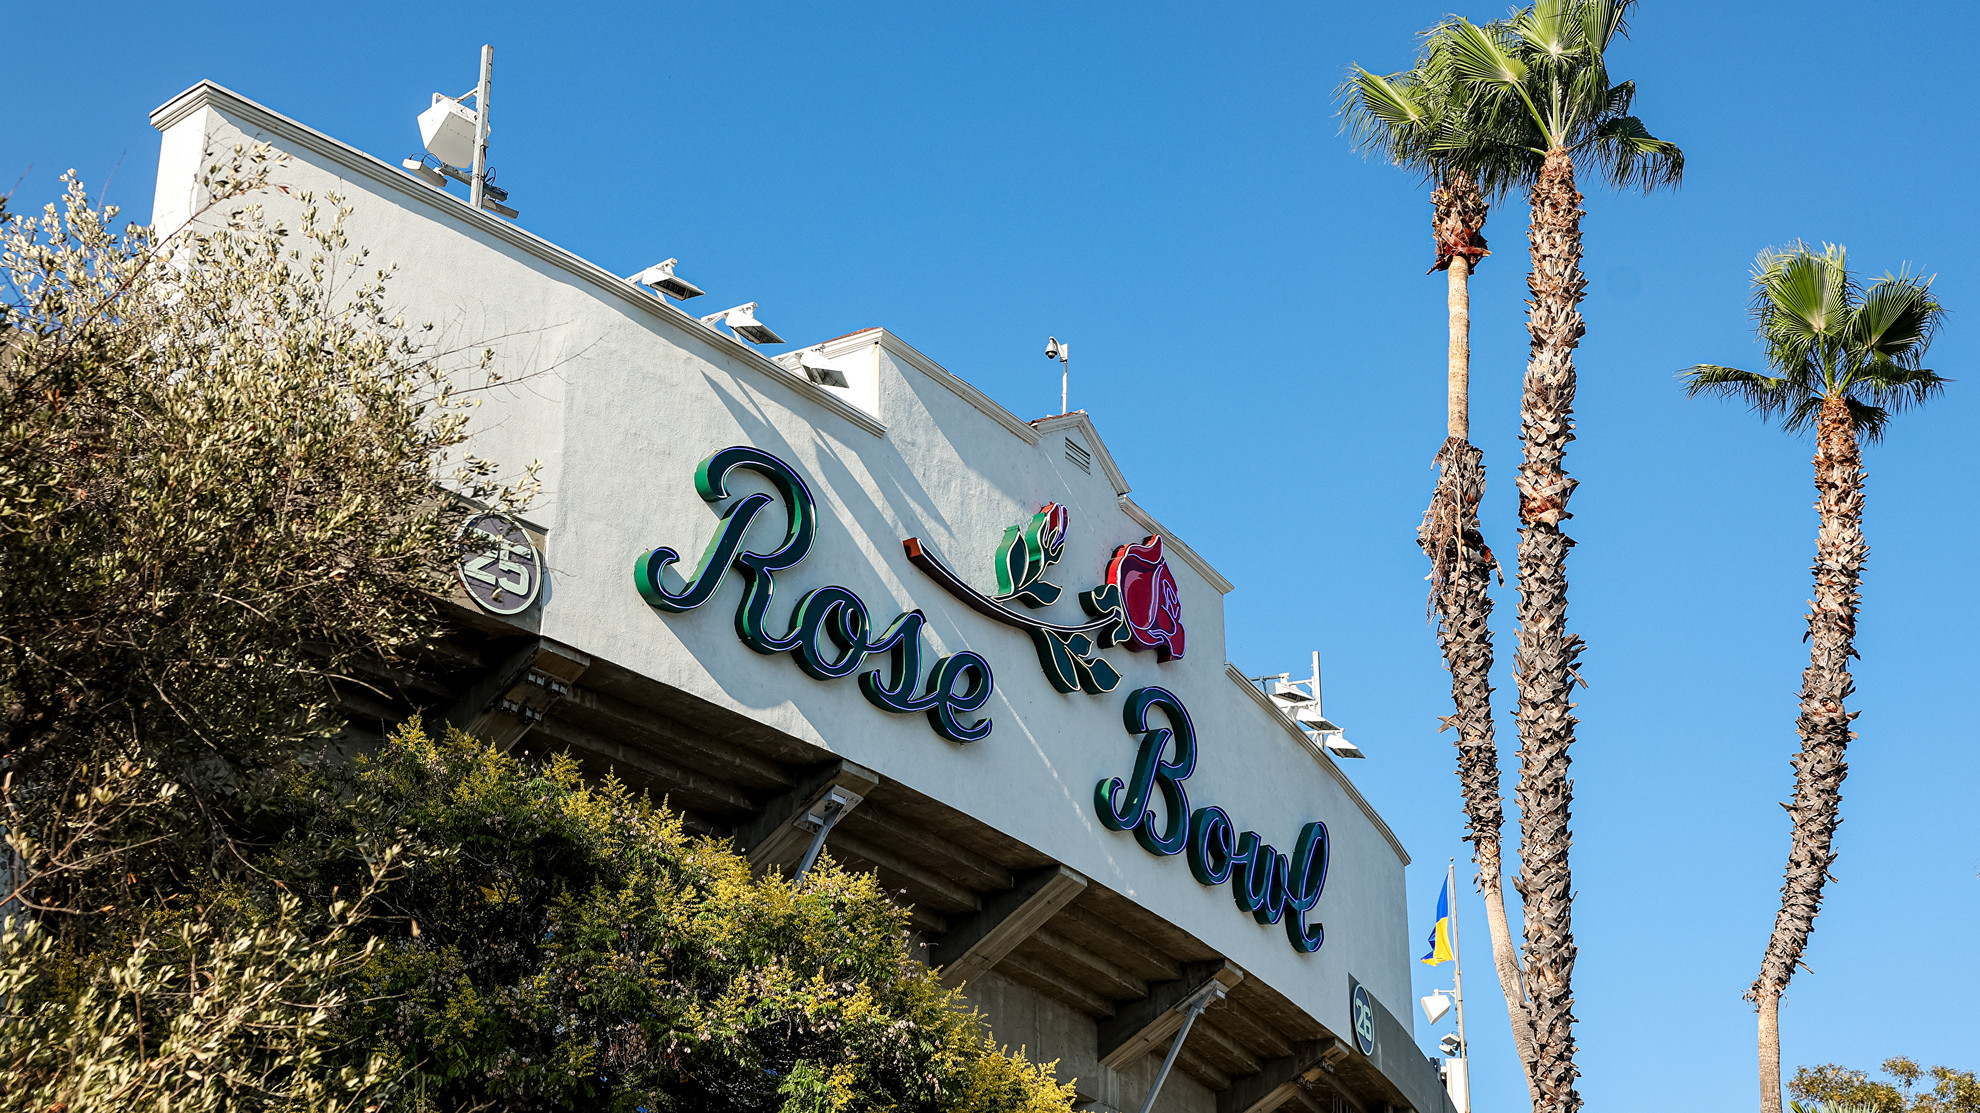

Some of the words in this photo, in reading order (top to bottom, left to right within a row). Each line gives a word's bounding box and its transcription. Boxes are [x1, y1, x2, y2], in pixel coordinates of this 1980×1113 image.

[464, 527, 531, 596] 25
[634, 446, 993, 743] Rose
[1094, 686, 1330, 953] Bowl
[1356, 998, 1372, 1042] 26
